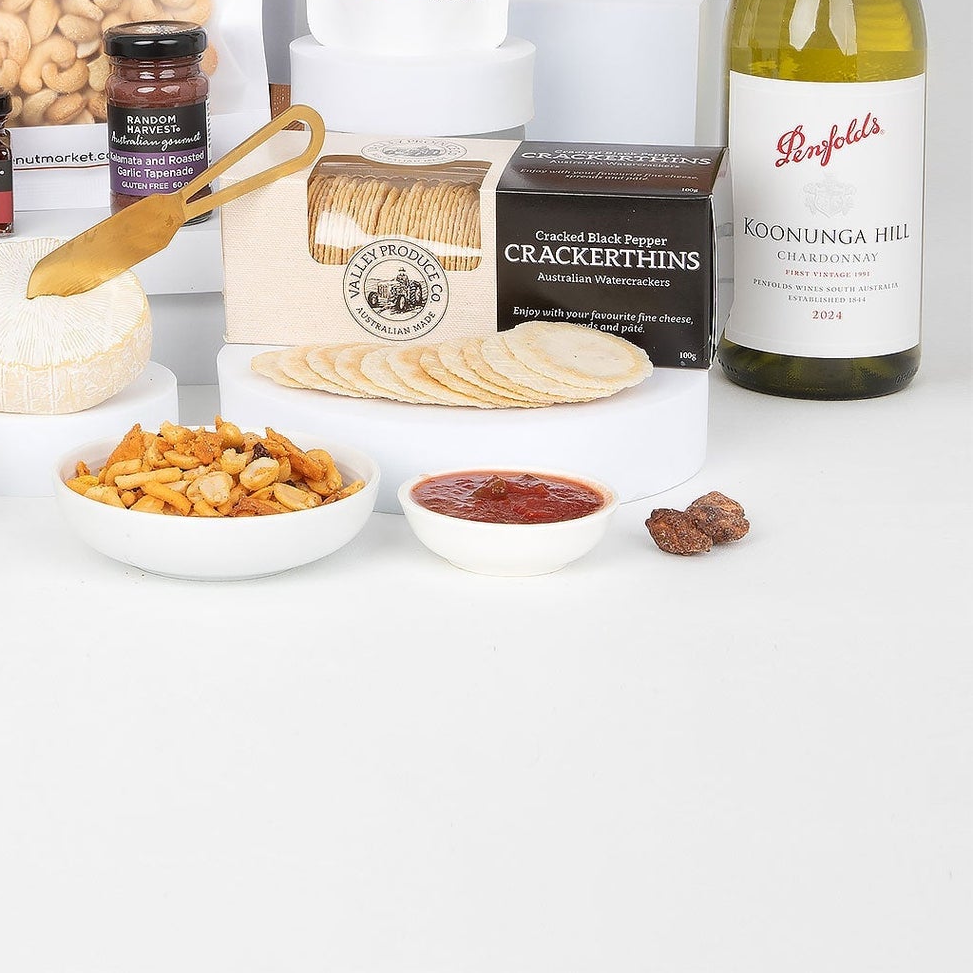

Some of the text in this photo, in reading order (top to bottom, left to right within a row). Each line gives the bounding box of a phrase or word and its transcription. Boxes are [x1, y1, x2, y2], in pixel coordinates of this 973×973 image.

[127, 115, 176, 124] RANDOM
[111, 131, 201, 151] Australian gourmet
[145, 150, 205, 165] and Roasted
[521, 152, 712, 166] CRACKERTHINS
[117, 166, 194, 179] Garlic Tapenade
[121, 181, 148, 189] GLUTEN
[149, 181, 169, 190] FREE
[743, 217, 910, 245] KOONUNGA HILL
[535, 231, 667, 248] Cracked Black Pepper
[504, 243, 701, 271] CRACKERTHINS
[777, 250, 878, 263] CHARDONNAY
[348, 244, 440, 299] VALLEY PRODUCE
[785, 269, 810, 277] FIRST
[537, 272, 670, 287] Australian Watercrackers
[753, 278, 793, 290] PENFOLDS
[858, 282, 899, 292] AUSTRALIA
[788, 295, 846, 303] ESTABLISHED
[356, 307, 436, 335] AUSTRALIAN MADE
[513, 306, 694, 325] Enjoy with your favourite fine cheese,
[812, 310, 842, 320] 2024
[600, 323, 619, 332] and
[679, 351, 697, 362] 100g
